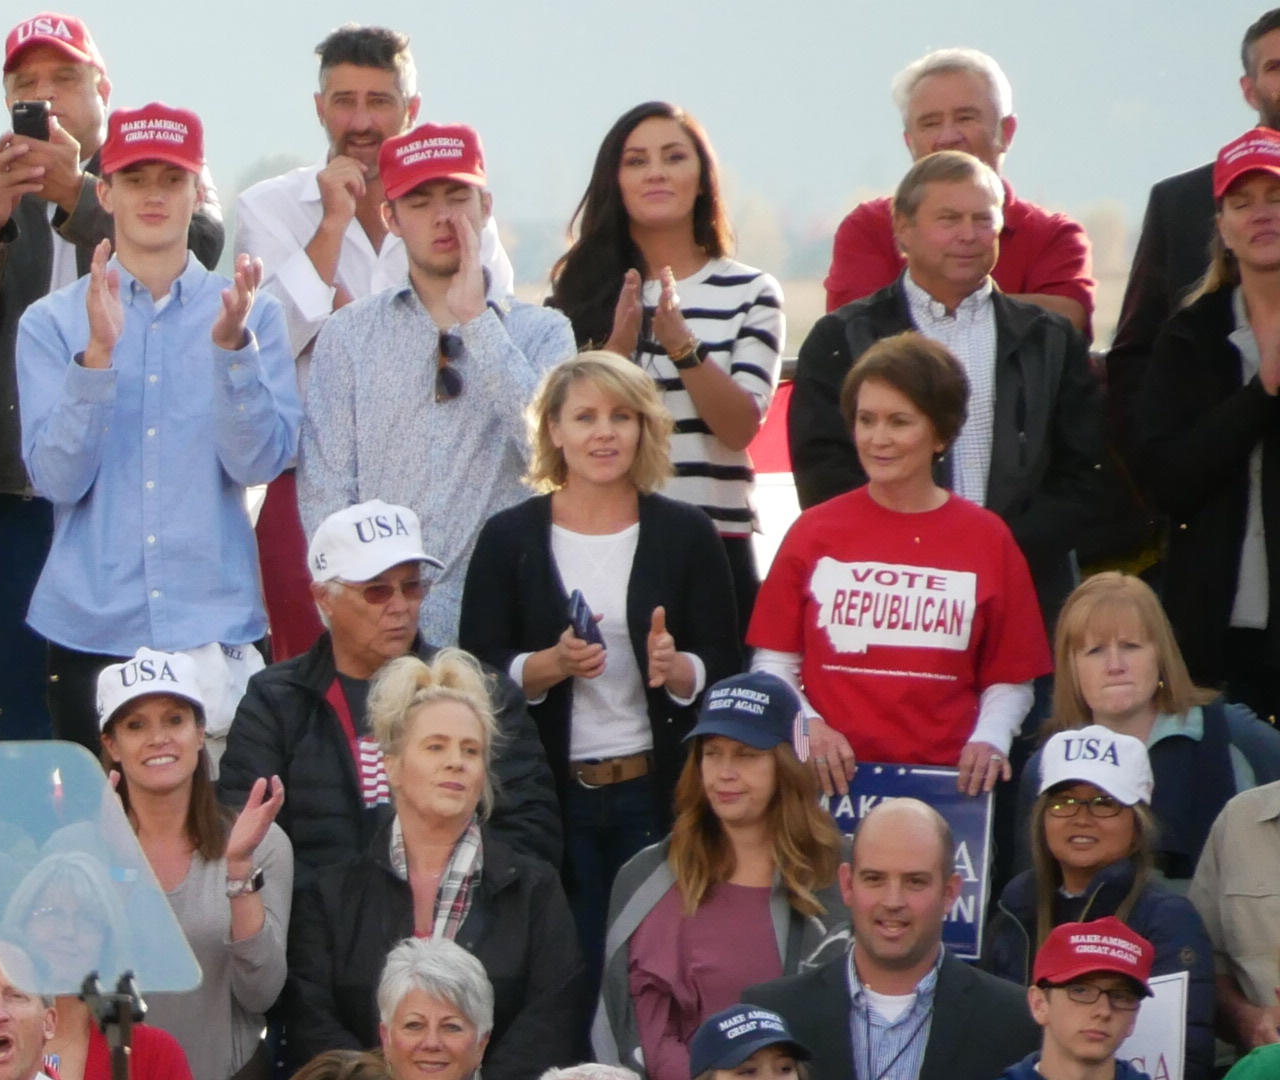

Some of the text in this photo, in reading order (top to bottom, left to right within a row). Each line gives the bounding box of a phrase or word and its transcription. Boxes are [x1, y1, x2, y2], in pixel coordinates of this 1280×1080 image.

[17, 18, 73, 43] USA
[121, 119, 188, 134] MAKE AMERICA
[125, 131, 184, 144] GREAT AGAIN
[396, 137, 465, 157] MAKE AMERICA
[403, 148, 462, 165] GREAT AGAIN
[354, 513, 408, 543] USA
[851, 567, 948, 591] VOTE
[830, 590, 965, 637] REPUBLICAN
[120, 660, 179, 687] USA
[711, 688, 769, 704] MAKE AMERICA
[709, 698, 764, 715] GREAT AGAIN
[1064, 738, 1120, 767] USA
[1070, 935, 1142, 956] MAKE AMERICA
[1075, 945, 1137, 965] GREAT AGAIN
[719, 1010, 782, 1031] MAKE AMERICA
[727, 1020, 784, 1039] GREAT AGAIN
